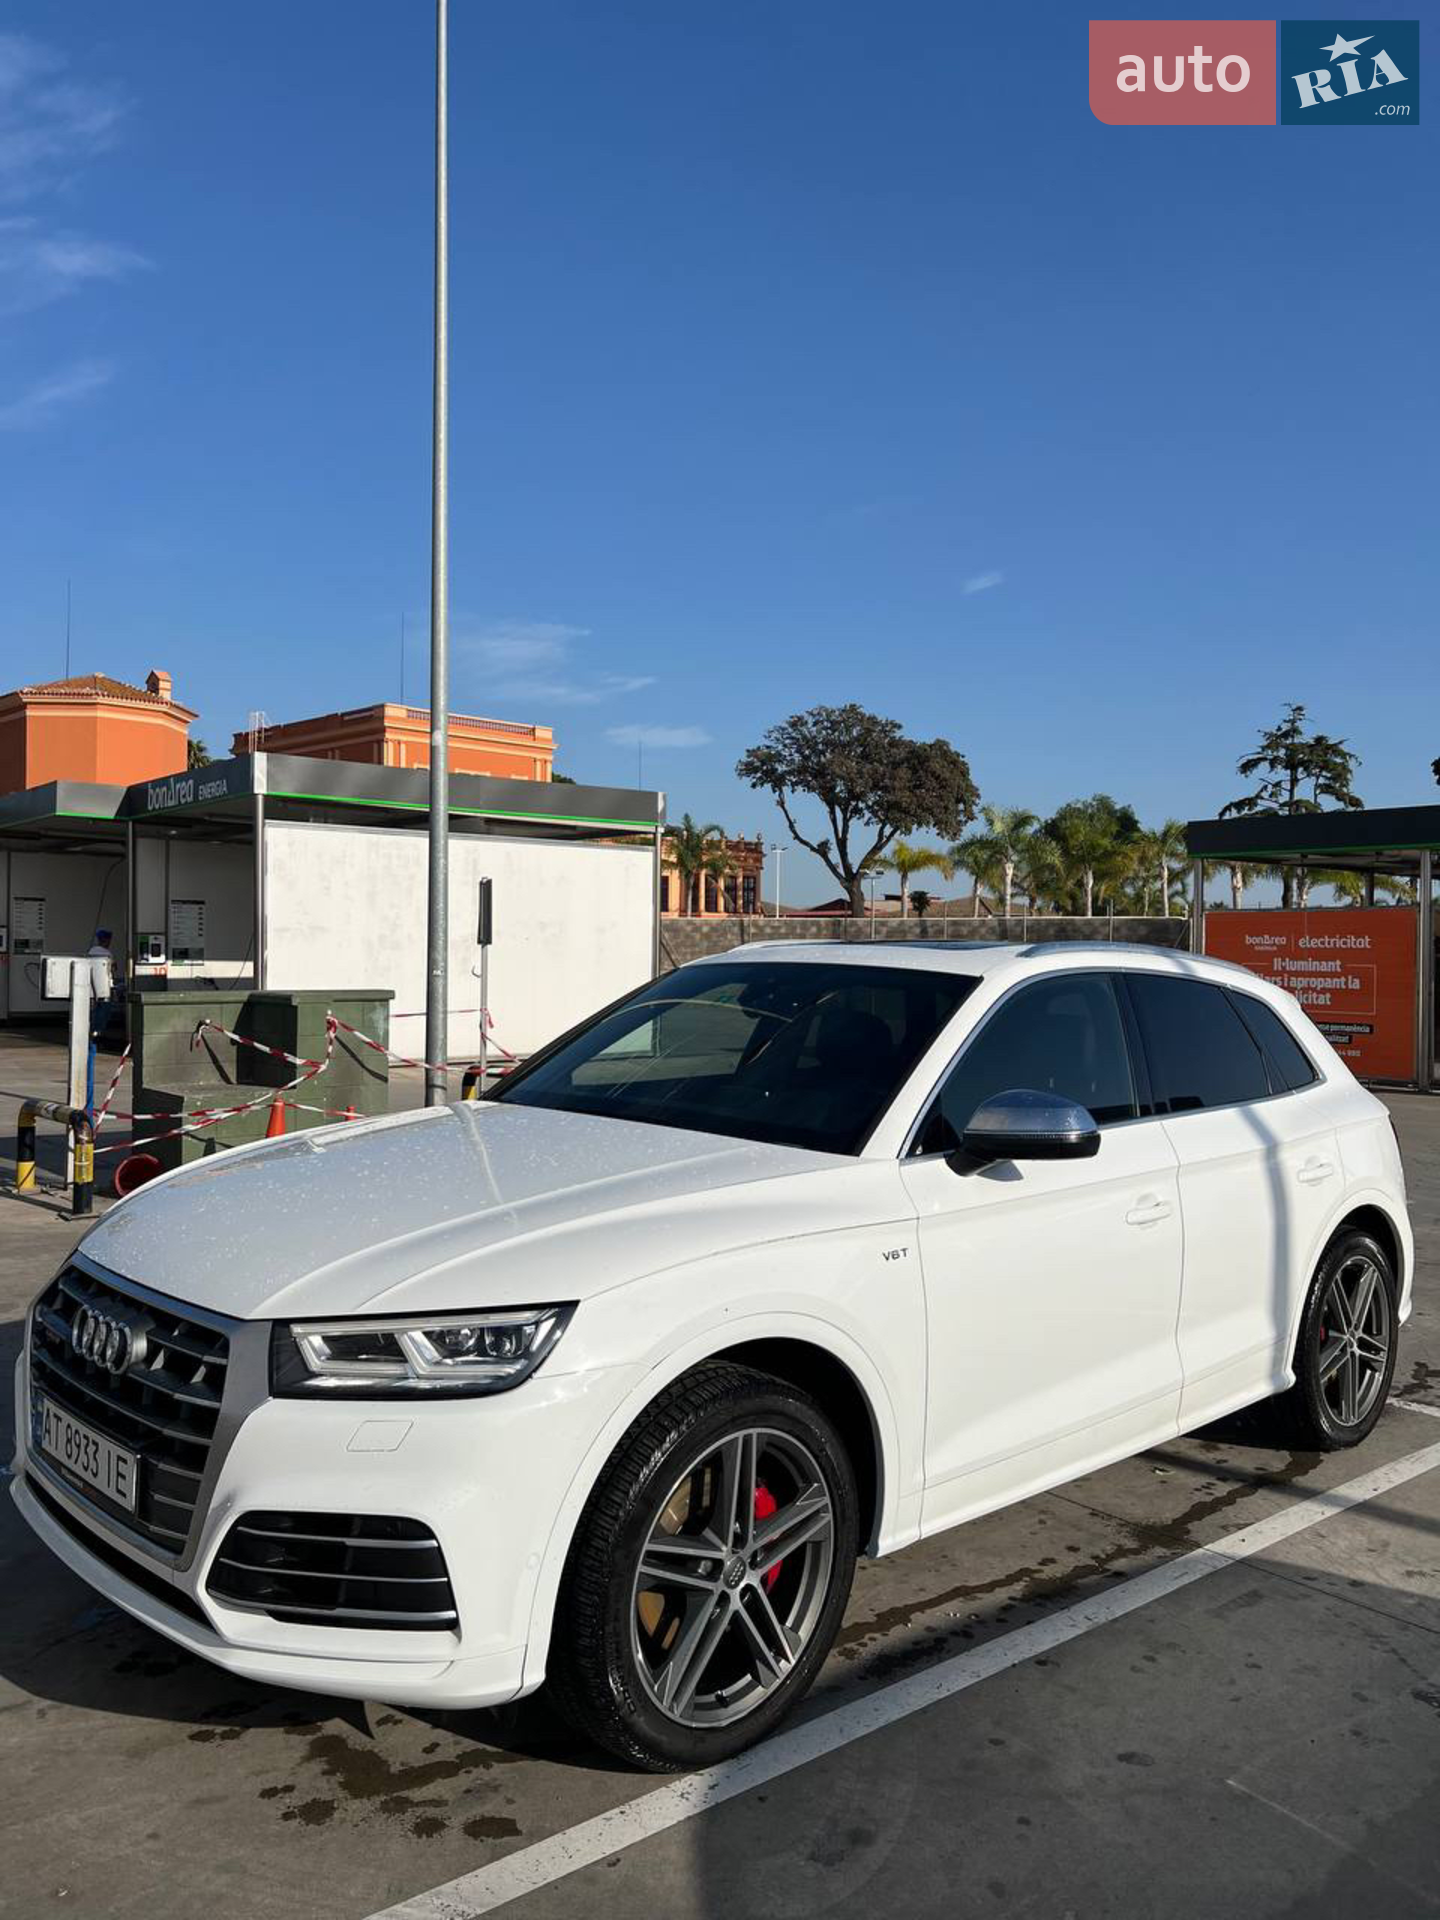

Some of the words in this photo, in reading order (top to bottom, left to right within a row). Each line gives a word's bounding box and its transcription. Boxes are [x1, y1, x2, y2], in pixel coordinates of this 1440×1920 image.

[1298, 935, 1371, 949] electricitat
[1289, 975, 1346, 990] apropant
[1348, 975, 1360, 989] la
[43, 1407, 63, 1451] AT
[65, 1422, 99, 1478] 8933
[107, 1449, 128, 1499] IE
